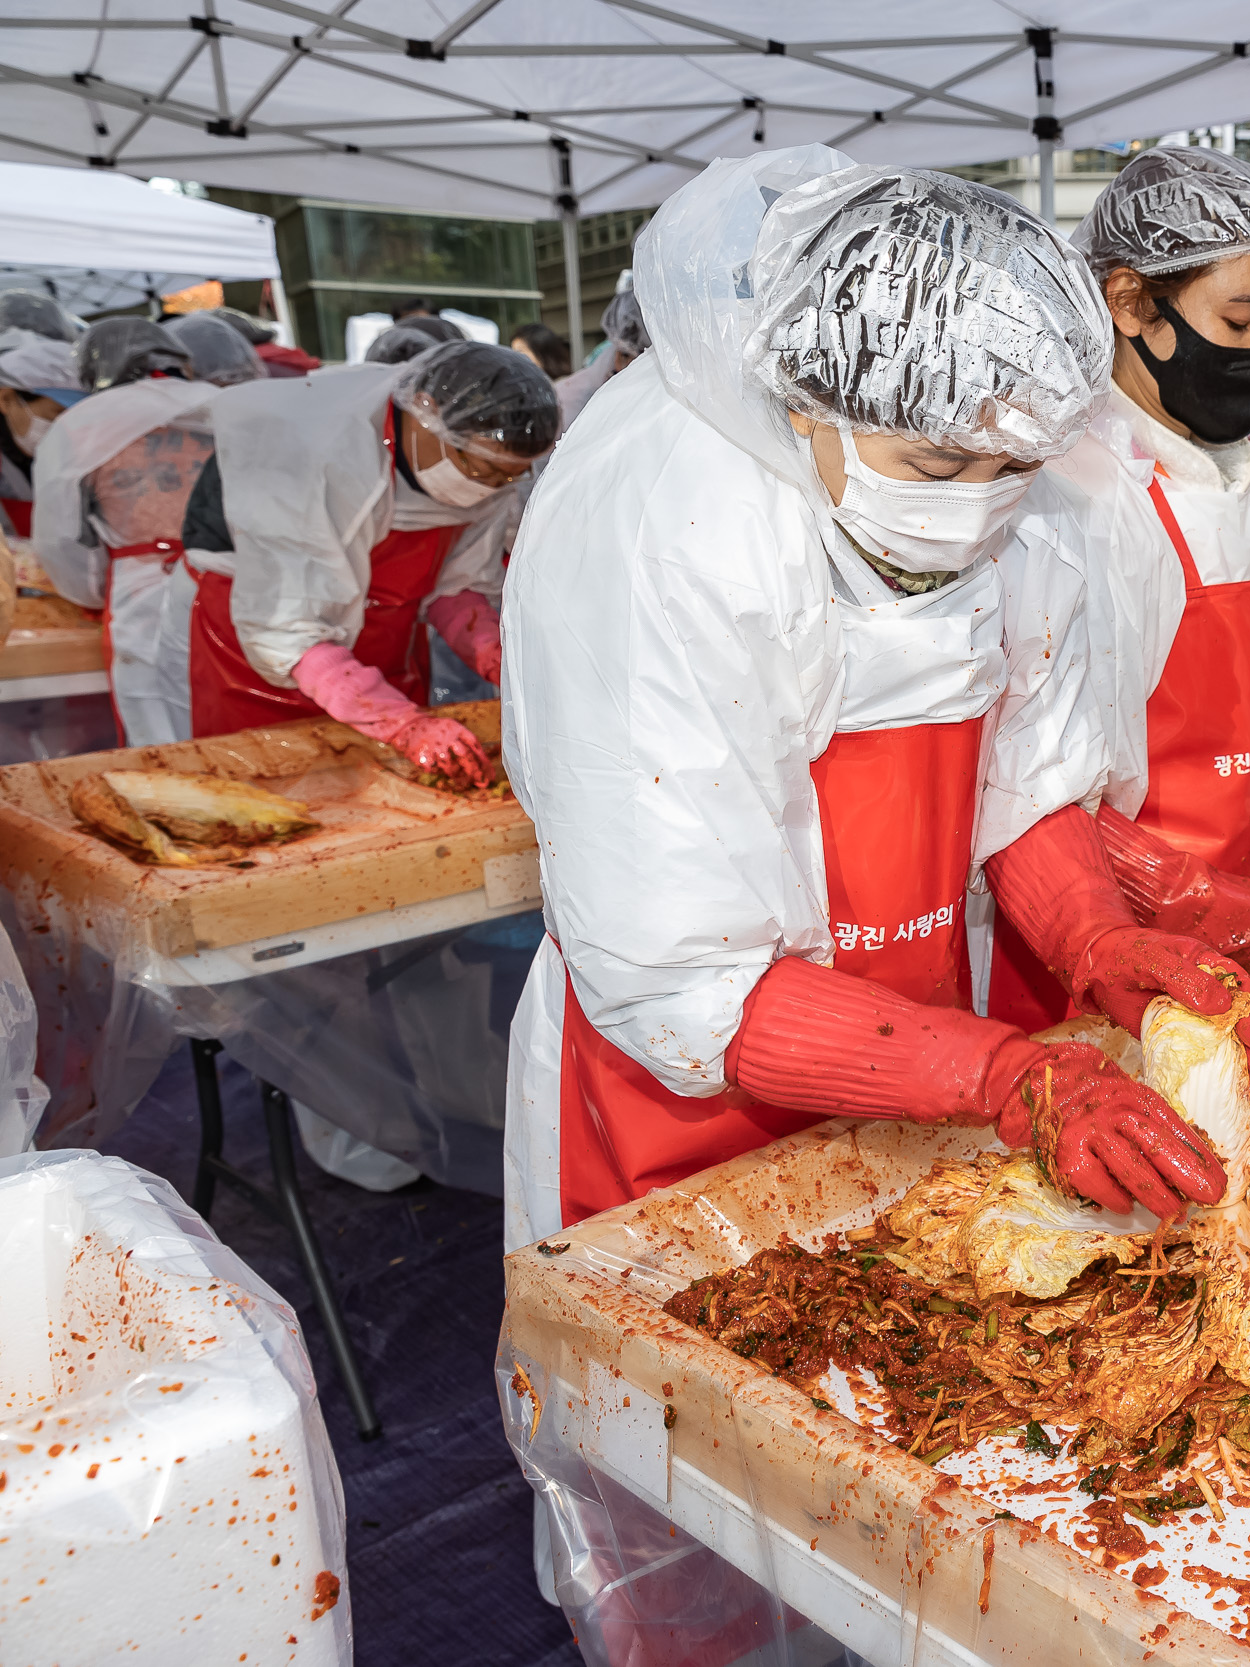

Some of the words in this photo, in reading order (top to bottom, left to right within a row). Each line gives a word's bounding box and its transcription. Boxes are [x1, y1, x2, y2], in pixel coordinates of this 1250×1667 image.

[1213, 752, 1250, 778] 광진
[834, 921, 886, 951] 광진
[892, 903, 954, 942] 사랑의
